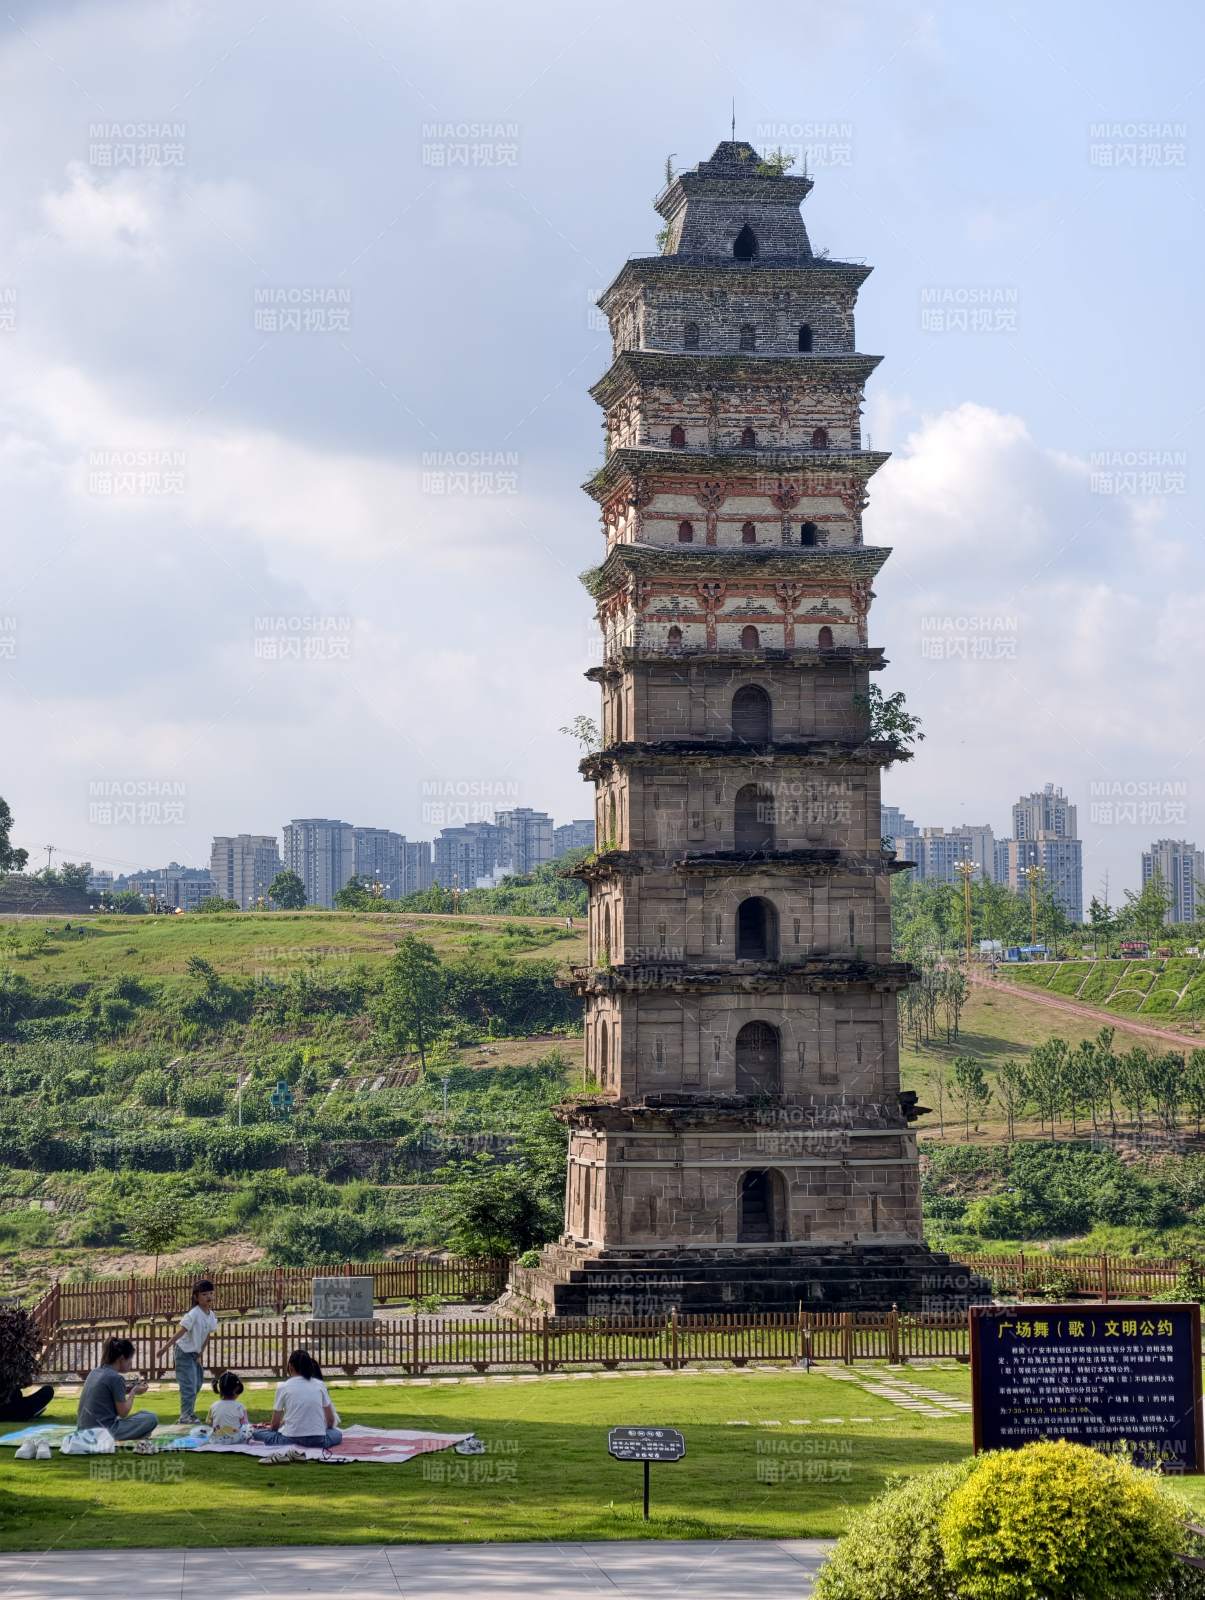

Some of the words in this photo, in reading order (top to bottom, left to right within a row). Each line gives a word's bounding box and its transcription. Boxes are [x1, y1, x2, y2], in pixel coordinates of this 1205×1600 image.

[997, 1320, 1174, 1338] 广场舞（歌）文明公约
